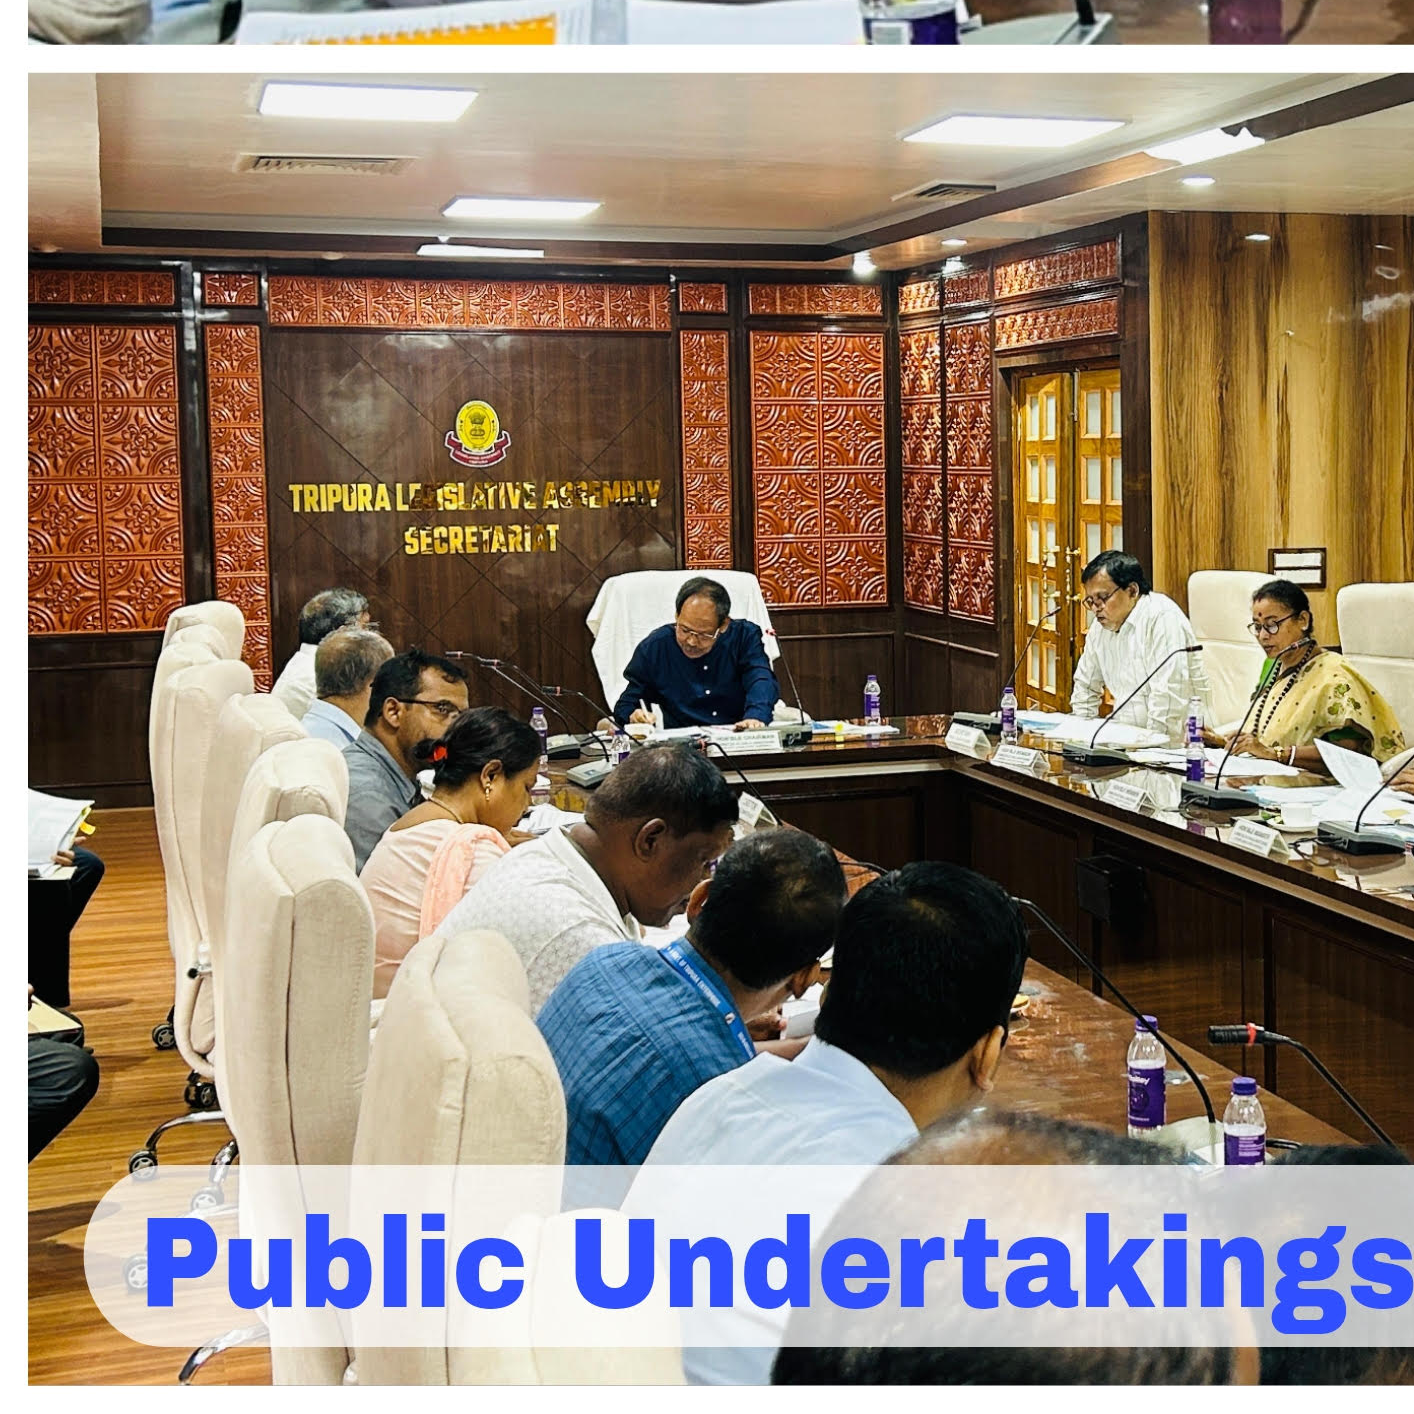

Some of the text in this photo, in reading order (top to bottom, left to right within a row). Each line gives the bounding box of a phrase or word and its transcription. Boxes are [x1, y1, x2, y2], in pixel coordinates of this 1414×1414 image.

[288, 483, 392, 513] TRIPURA
[396, 482, 538, 512] LEGISLATIVE
[404, 524, 560, 555] SECRETARIAT
